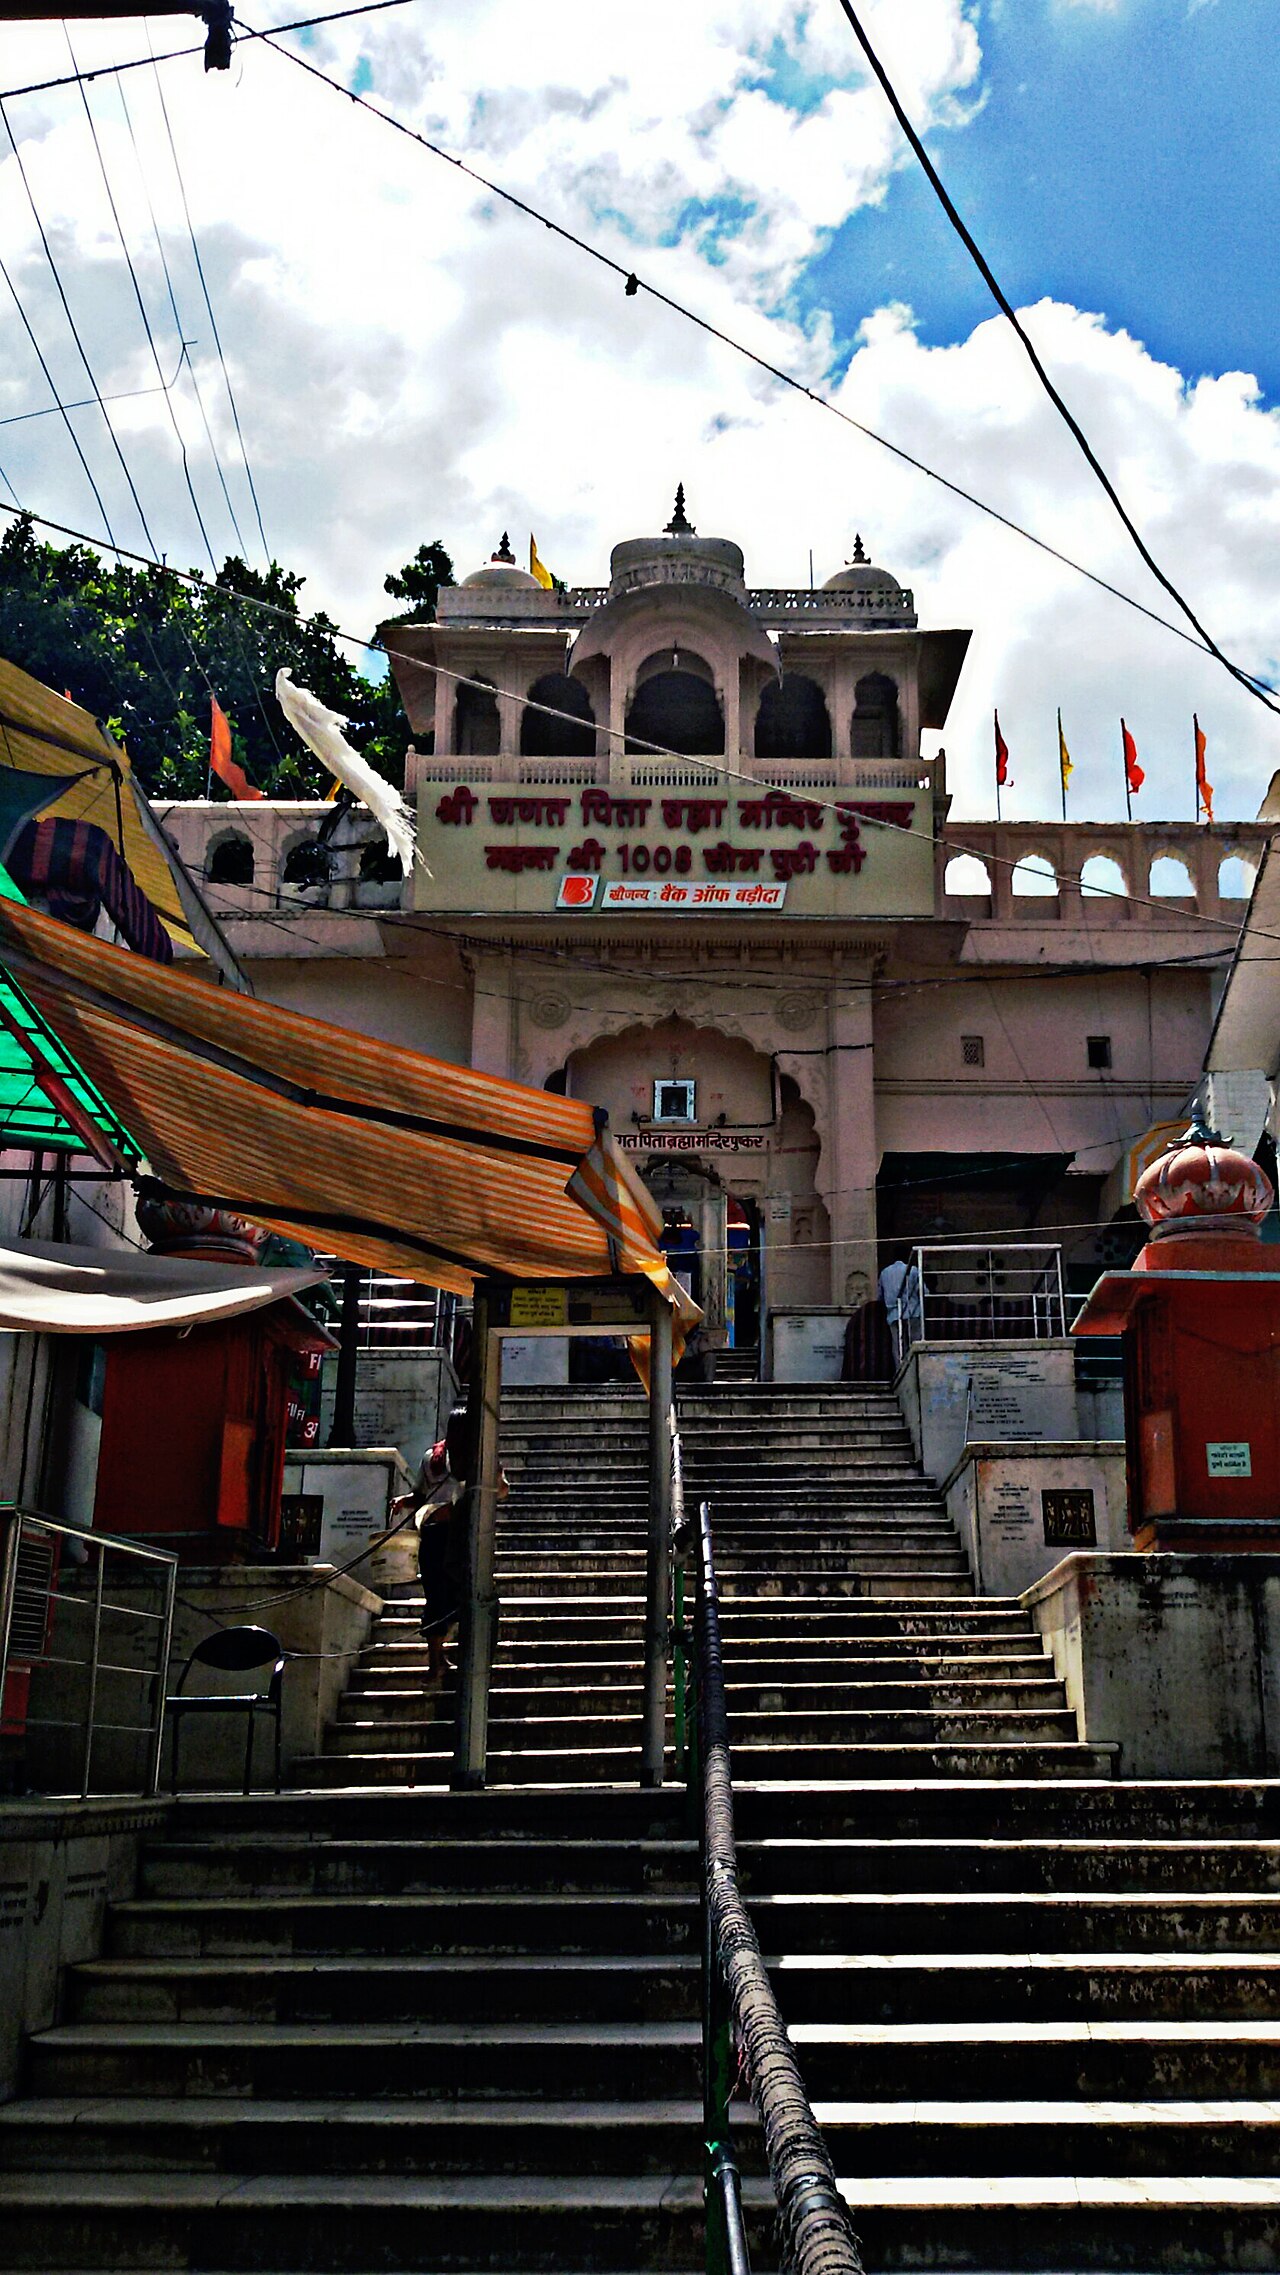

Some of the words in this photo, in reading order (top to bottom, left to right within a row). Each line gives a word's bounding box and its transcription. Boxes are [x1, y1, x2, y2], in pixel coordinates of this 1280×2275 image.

[436, 786, 478, 825] श्री
[580, 789, 652, 827] पिता
[567, 839, 606, 871] श्री
[617, 844, 691, 874] 1008
[826, 842, 866, 874] जी
[660, 884, 688, 902] बैंक
[692, 885, 731, 902] ऑफ
